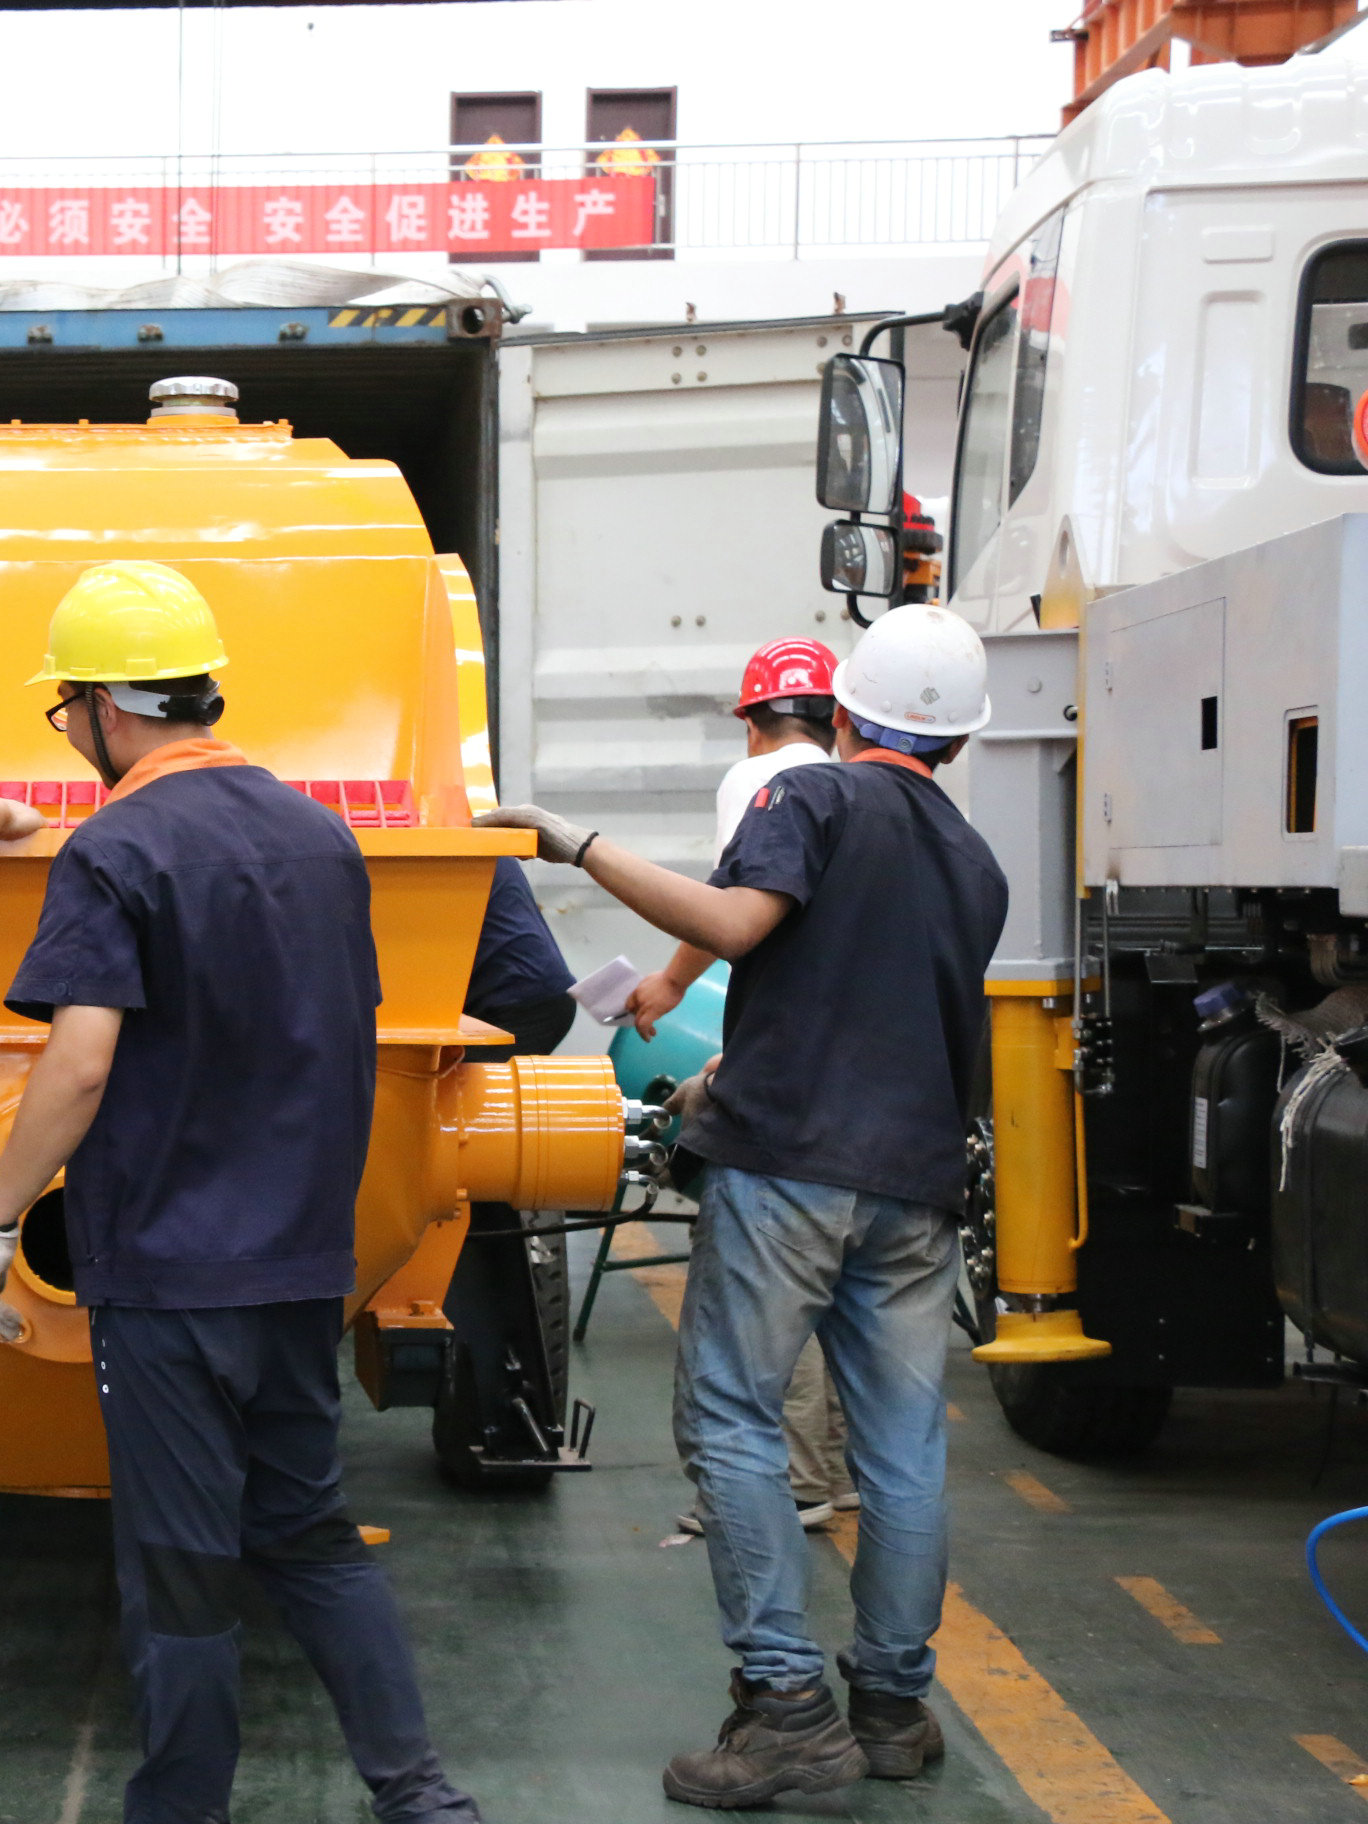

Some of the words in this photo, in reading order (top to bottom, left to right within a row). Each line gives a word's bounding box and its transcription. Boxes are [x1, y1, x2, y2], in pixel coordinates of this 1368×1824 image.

[262, 188, 616, 243] 安全促进生产
